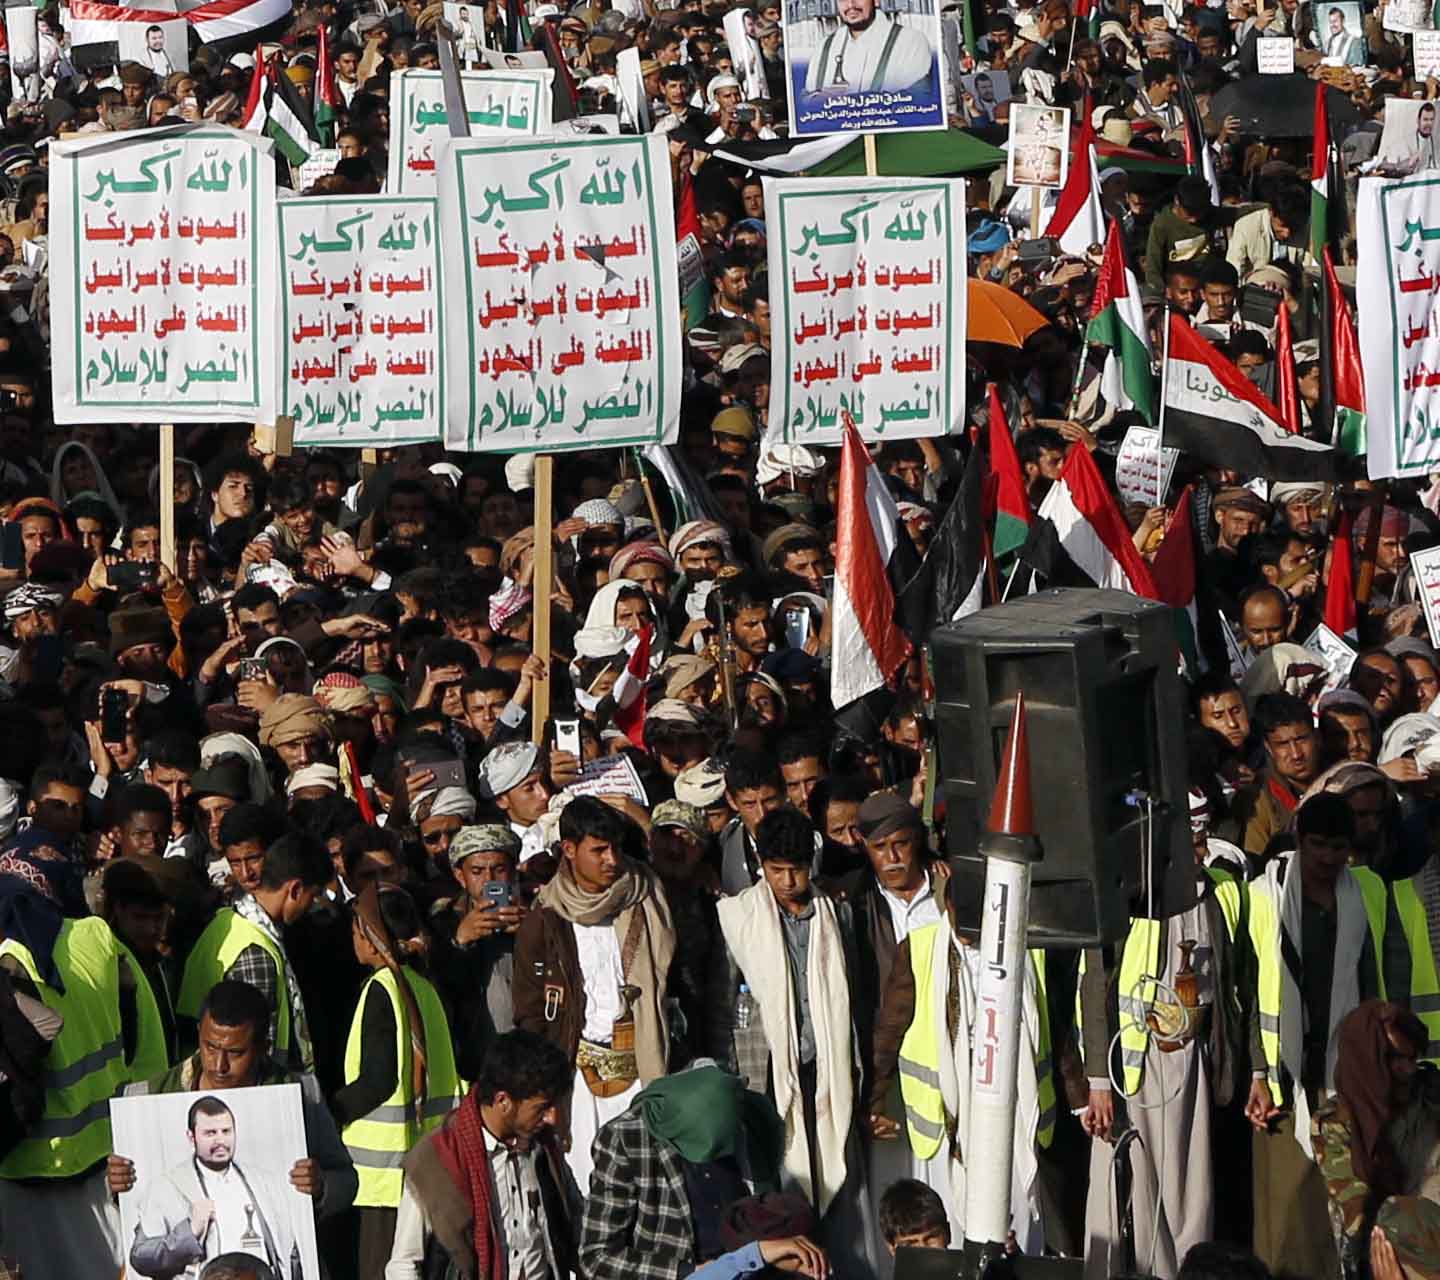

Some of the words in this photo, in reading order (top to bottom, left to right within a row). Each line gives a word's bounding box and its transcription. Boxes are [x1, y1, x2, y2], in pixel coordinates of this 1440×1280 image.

[83, 148, 182, 208] أكبر
[185, 149, 247, 192] الله
[579, 156, 642, 205] الله
[84, 211, 169, 247] لأمريكا
[176, 211, 246, 245] الموت
[884, 199, 941, 241] الله
[84, 257, 171, 294] لإسرائيل
[177, 259, 246, 292] الموت
[874, 258, 941, 292] الموت
[573, 276, 650, 316] الموت
[84, 304, 145, 340] اليهود
[153, 303, 186, 339] على
[195, 302, 246, 332] اللعنة
[874, 302, 941, 336] الموت
[550, 333, 585, 376] على
[594, 327, 651, 363] اللعنة
[890, 344, 940, 373] اللعنة
[85, 346, 168, 396] للإسلام
[175, 343, 247, 393] النصر
[793, 351, 845, 389] اليهود
[851, 349, 882, 383] على
[572, 378, 652, 433] النصر
[873, 383, 940, 433] النصر
